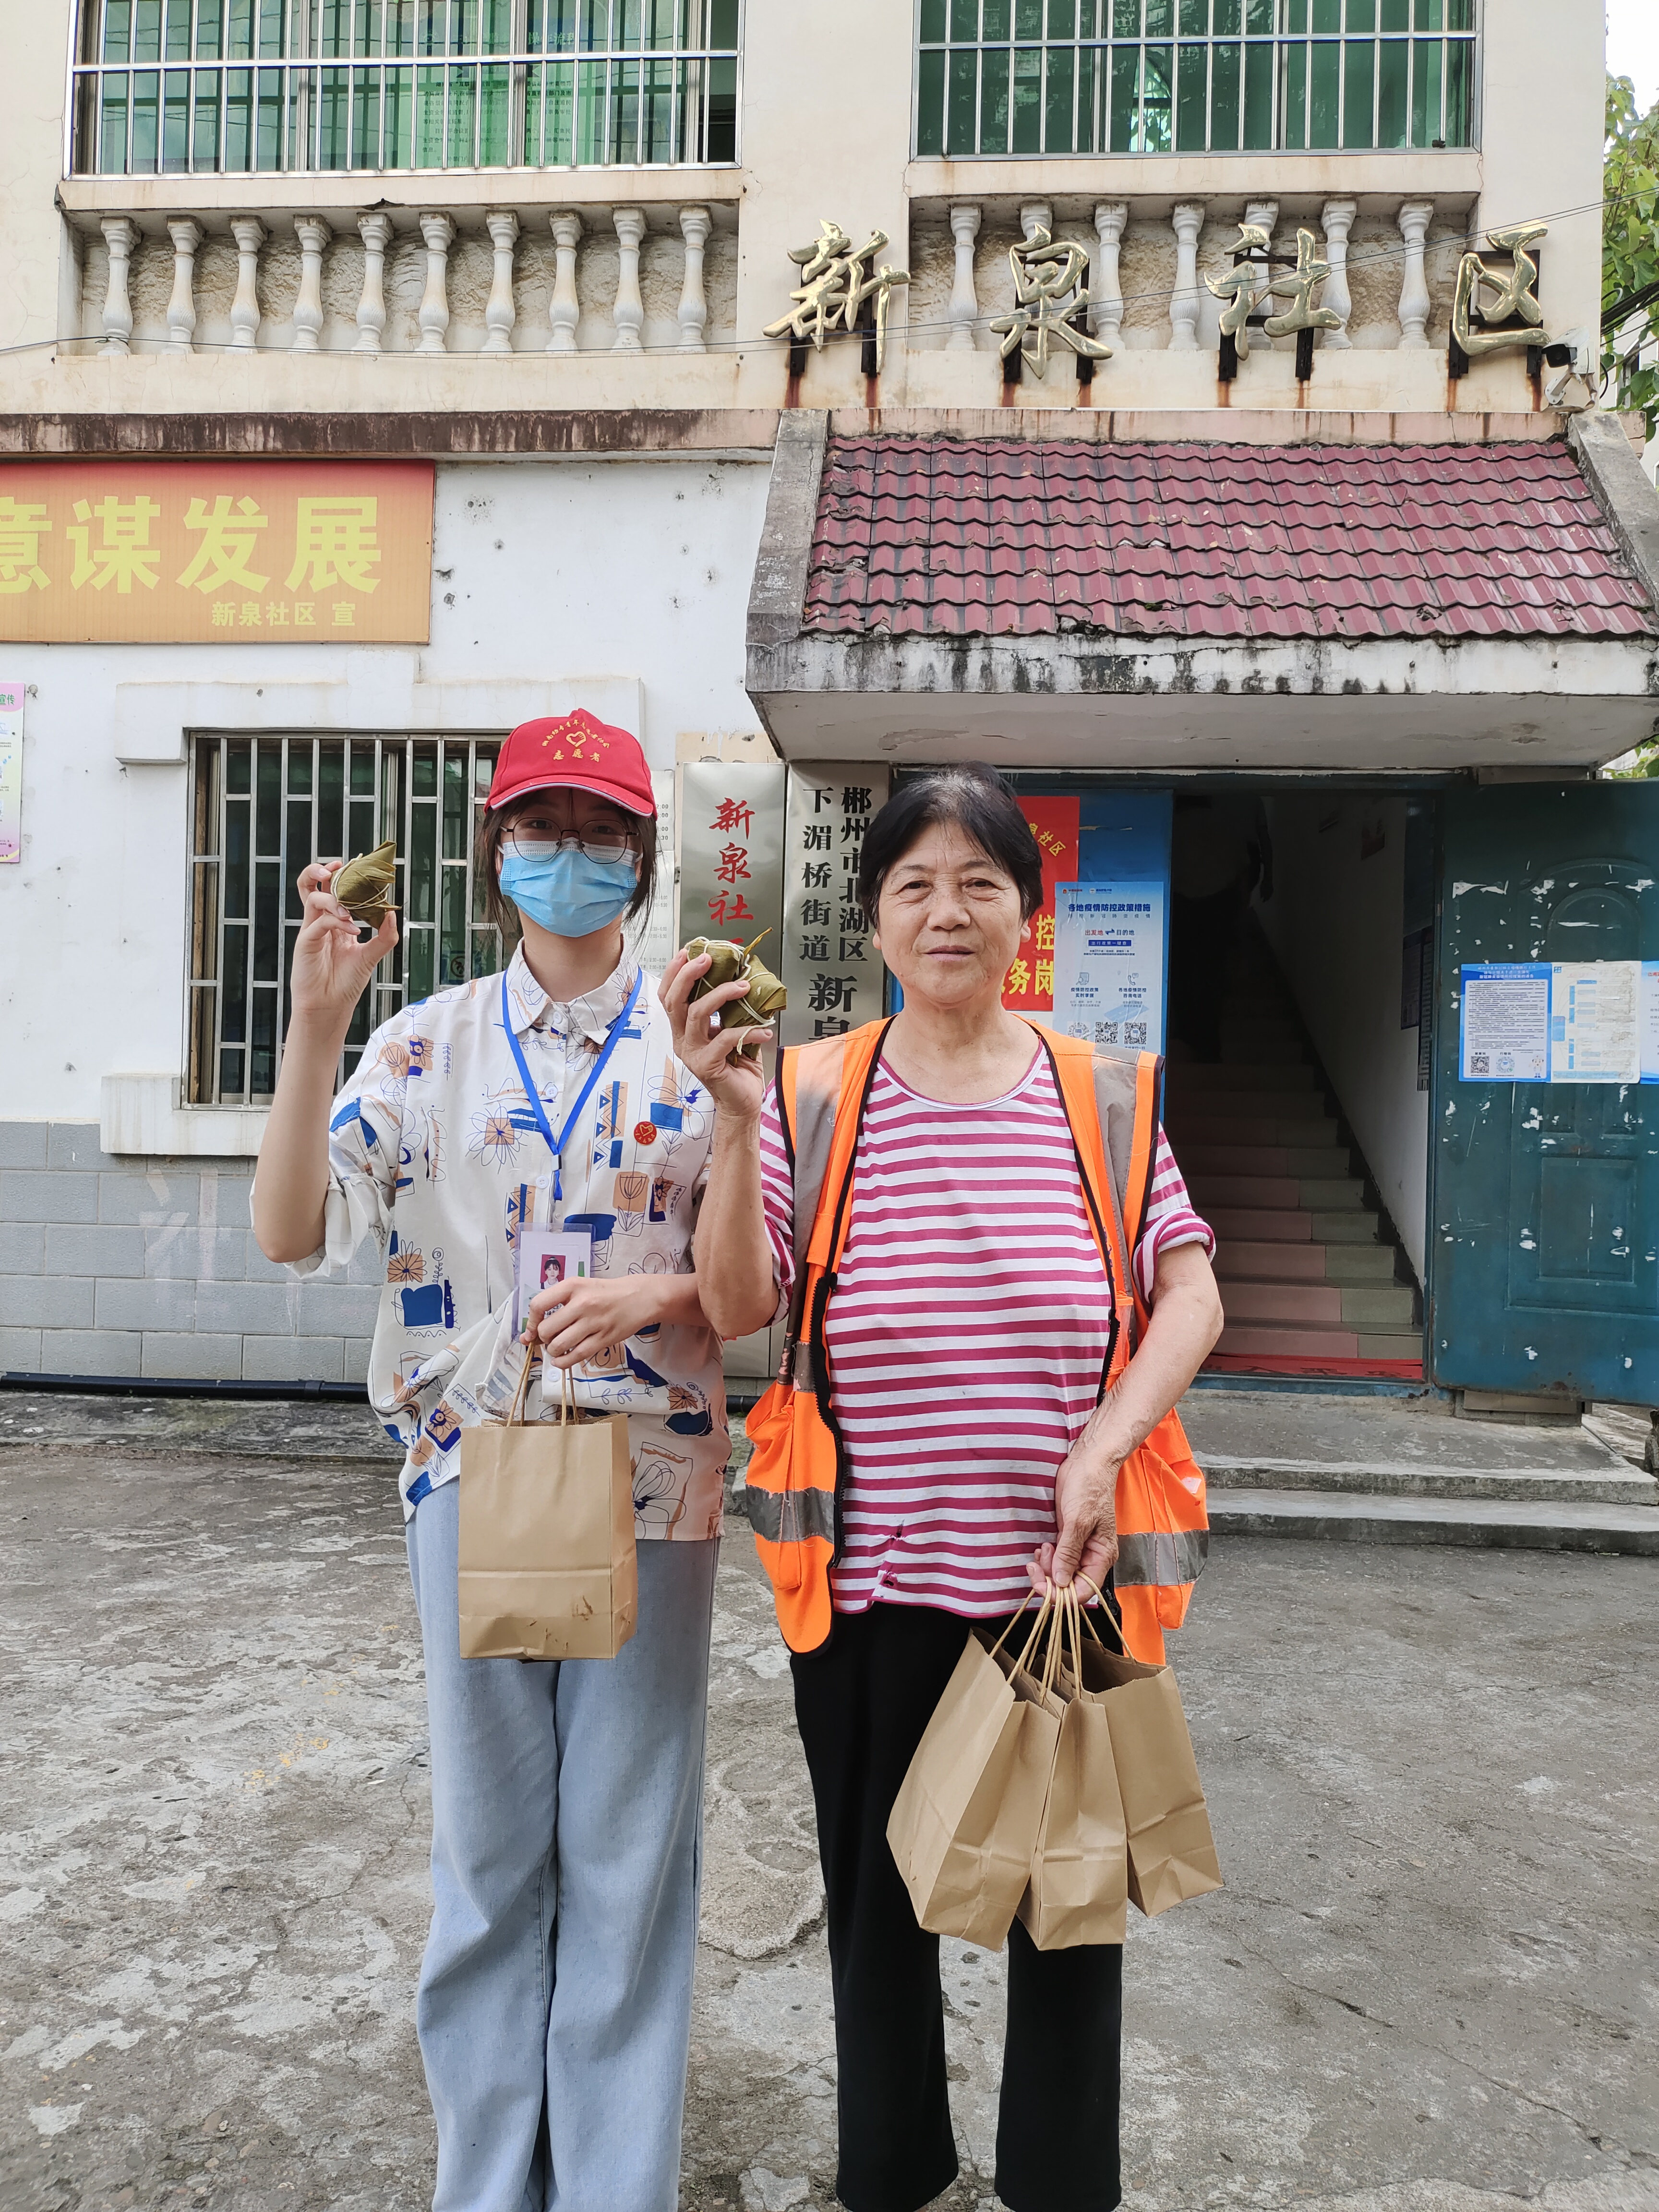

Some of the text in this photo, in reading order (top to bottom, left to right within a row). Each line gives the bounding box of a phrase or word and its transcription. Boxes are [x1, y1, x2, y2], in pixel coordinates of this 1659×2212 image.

[762, 219, 1551, 380] 新泉社区
[0, 495, 382, 594] 意谋发展
[212, 601, 356, 626] 新泉社区 宣
[553, 748, 601, 762] 志愿者
[709, 797, 756, 944] 新泉社
[799, 787, 834, 962] 下湄桥街道
[838, 786, 873, 962] 郴州市北湖区
[1035, 914, 1055, 950] 控
[1068, 903, 1151, 912] 各地疫情防控政策措施
[1001, 958, 1054, 996] 务岗
